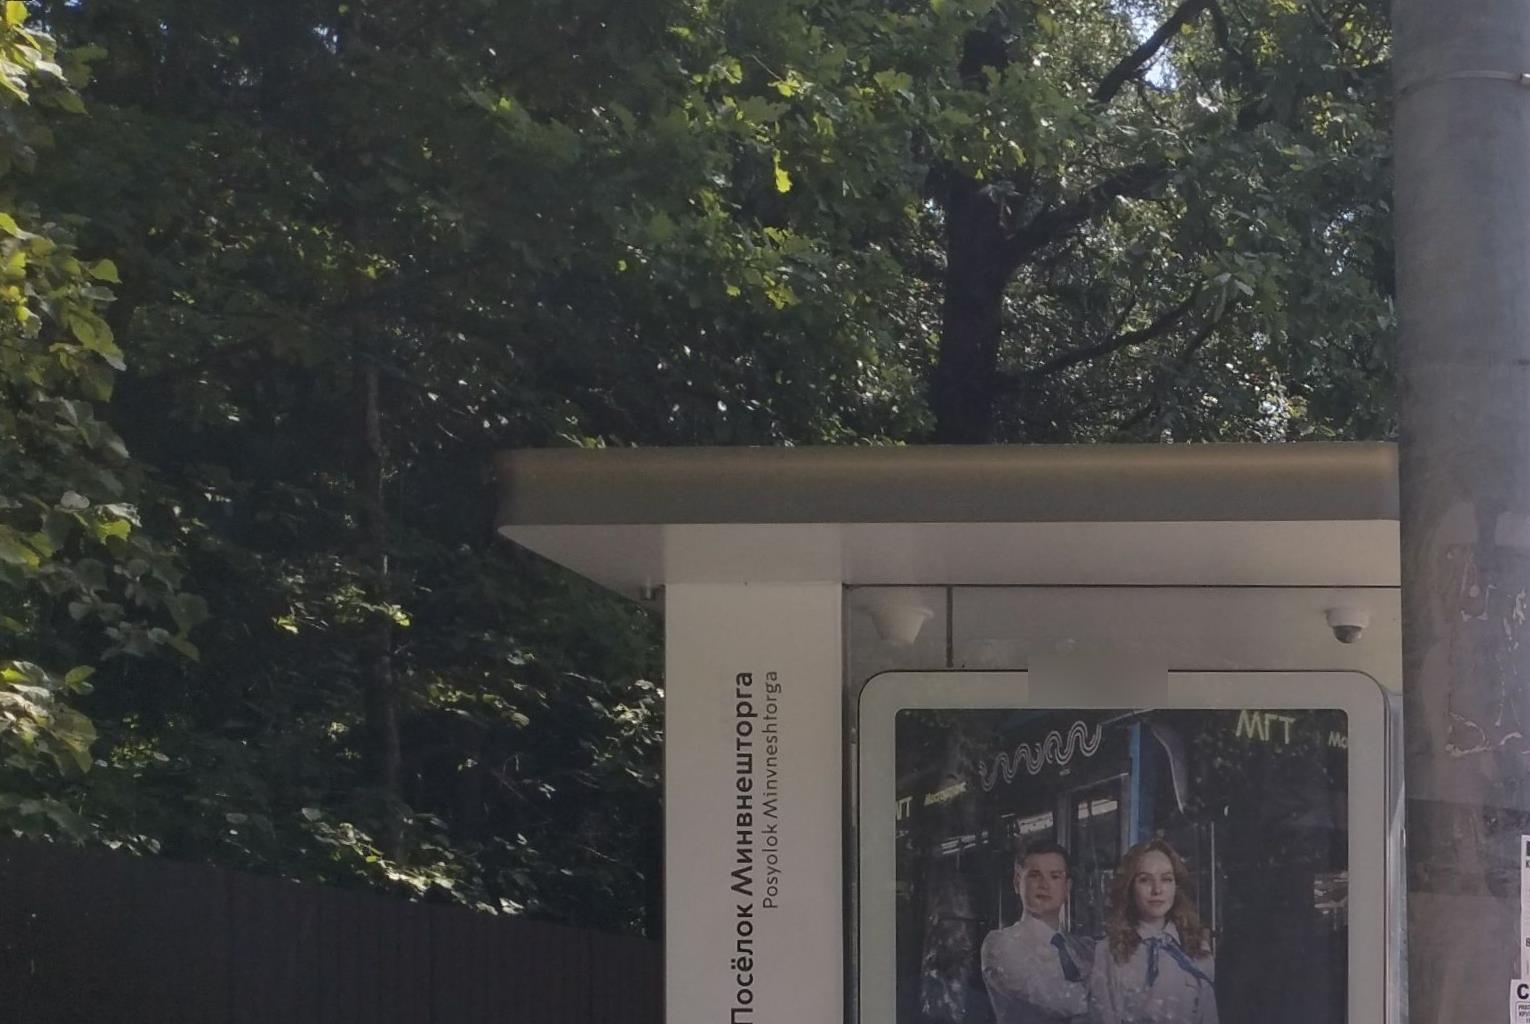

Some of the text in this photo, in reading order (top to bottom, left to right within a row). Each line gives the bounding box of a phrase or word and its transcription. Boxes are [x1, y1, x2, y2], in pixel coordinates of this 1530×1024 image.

[731, 672, 758, 897] Минвнешторга
[763, 671, 783, 909] Posyolok Minvneshtorga
